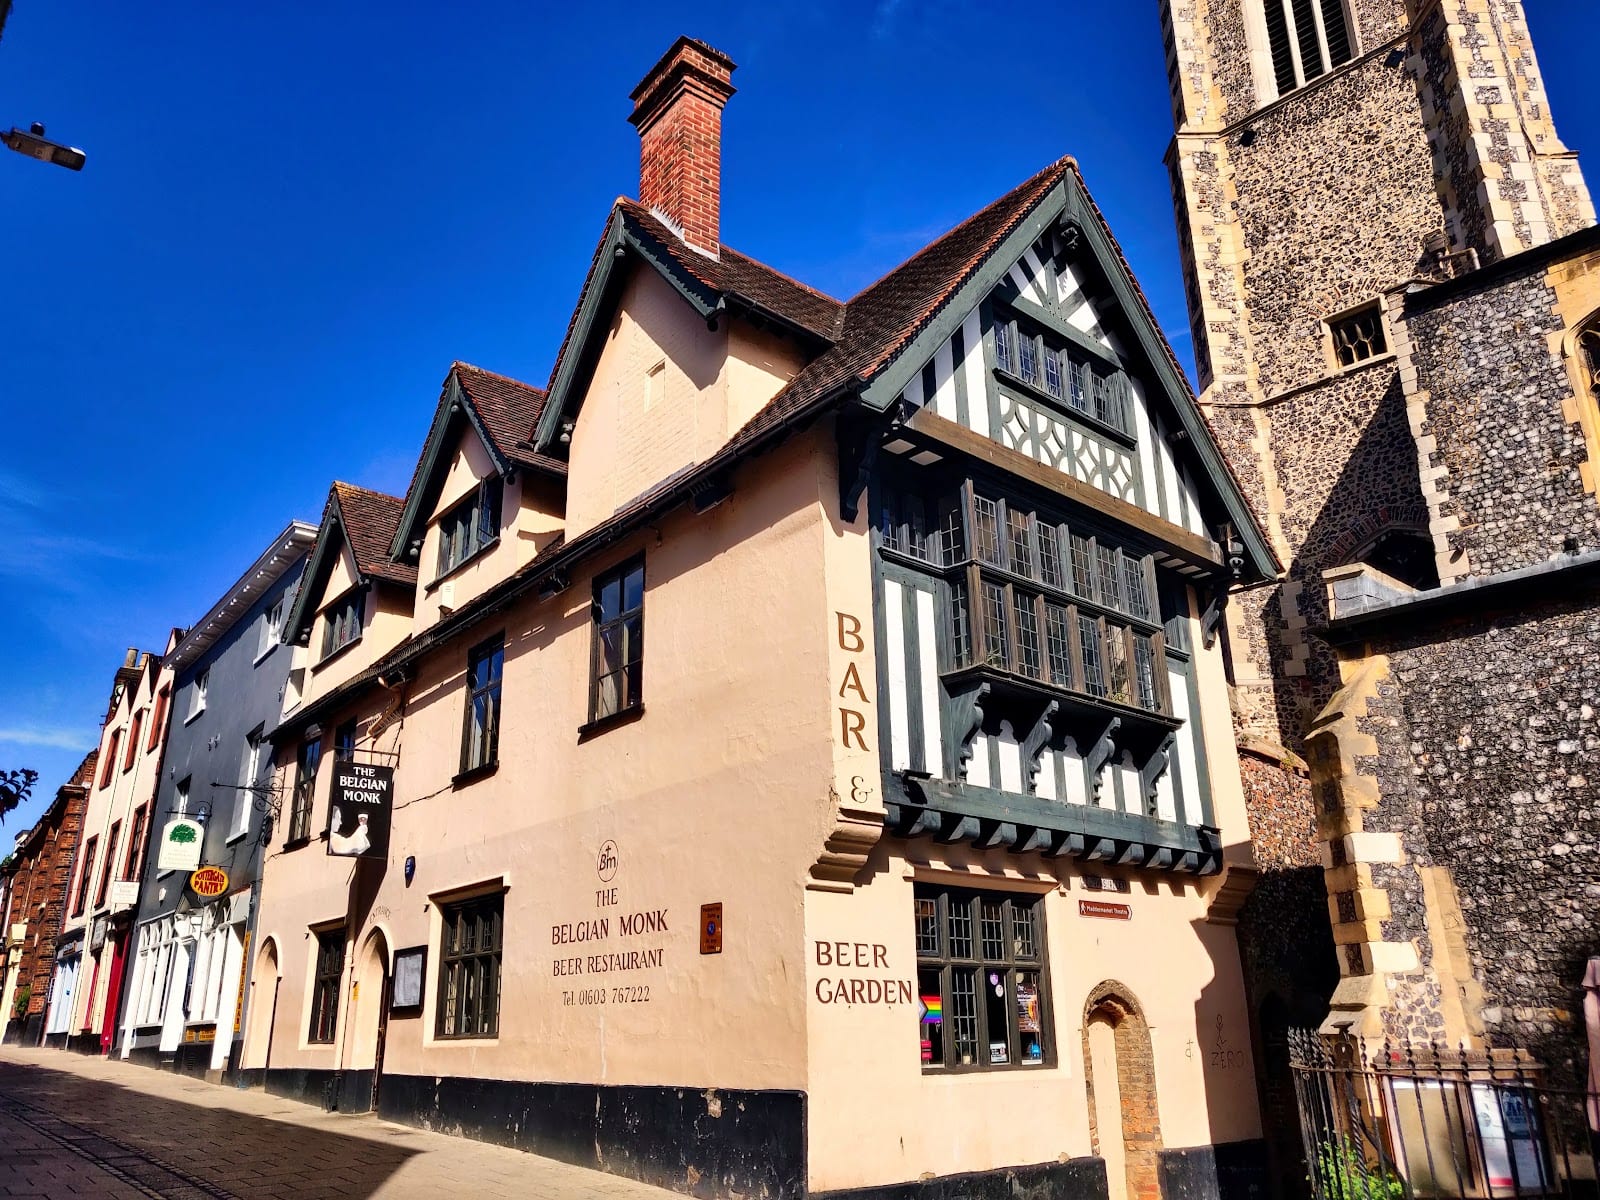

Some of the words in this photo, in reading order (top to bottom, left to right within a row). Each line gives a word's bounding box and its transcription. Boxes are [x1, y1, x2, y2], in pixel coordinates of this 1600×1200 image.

[835, 610, 871, 752] BAR
[339, 775, 387, 791] BELGIAN
[353, 766, 376, 777] THE
[343, 789, 381, 804] MONK
[850, 775, 873, 804] &
[194, 880, 225, 895] PANTRY
[595, 887, 619, 908] THE
[551, 918, 609, 945] BELGIAN
[619, 908, 669, 937] MONK
[553, 957, 583, 977] BEER
[586, 948, 665, 974] RESTAURANT
[814, 940, 890, 968] BEER
[562, 991, 576, 1006] Tel.
[578, 988, 607, 1006] 01603
[611, 985, 651, 1004] 767222
[815, 977, 912, 1004] GARDEN
